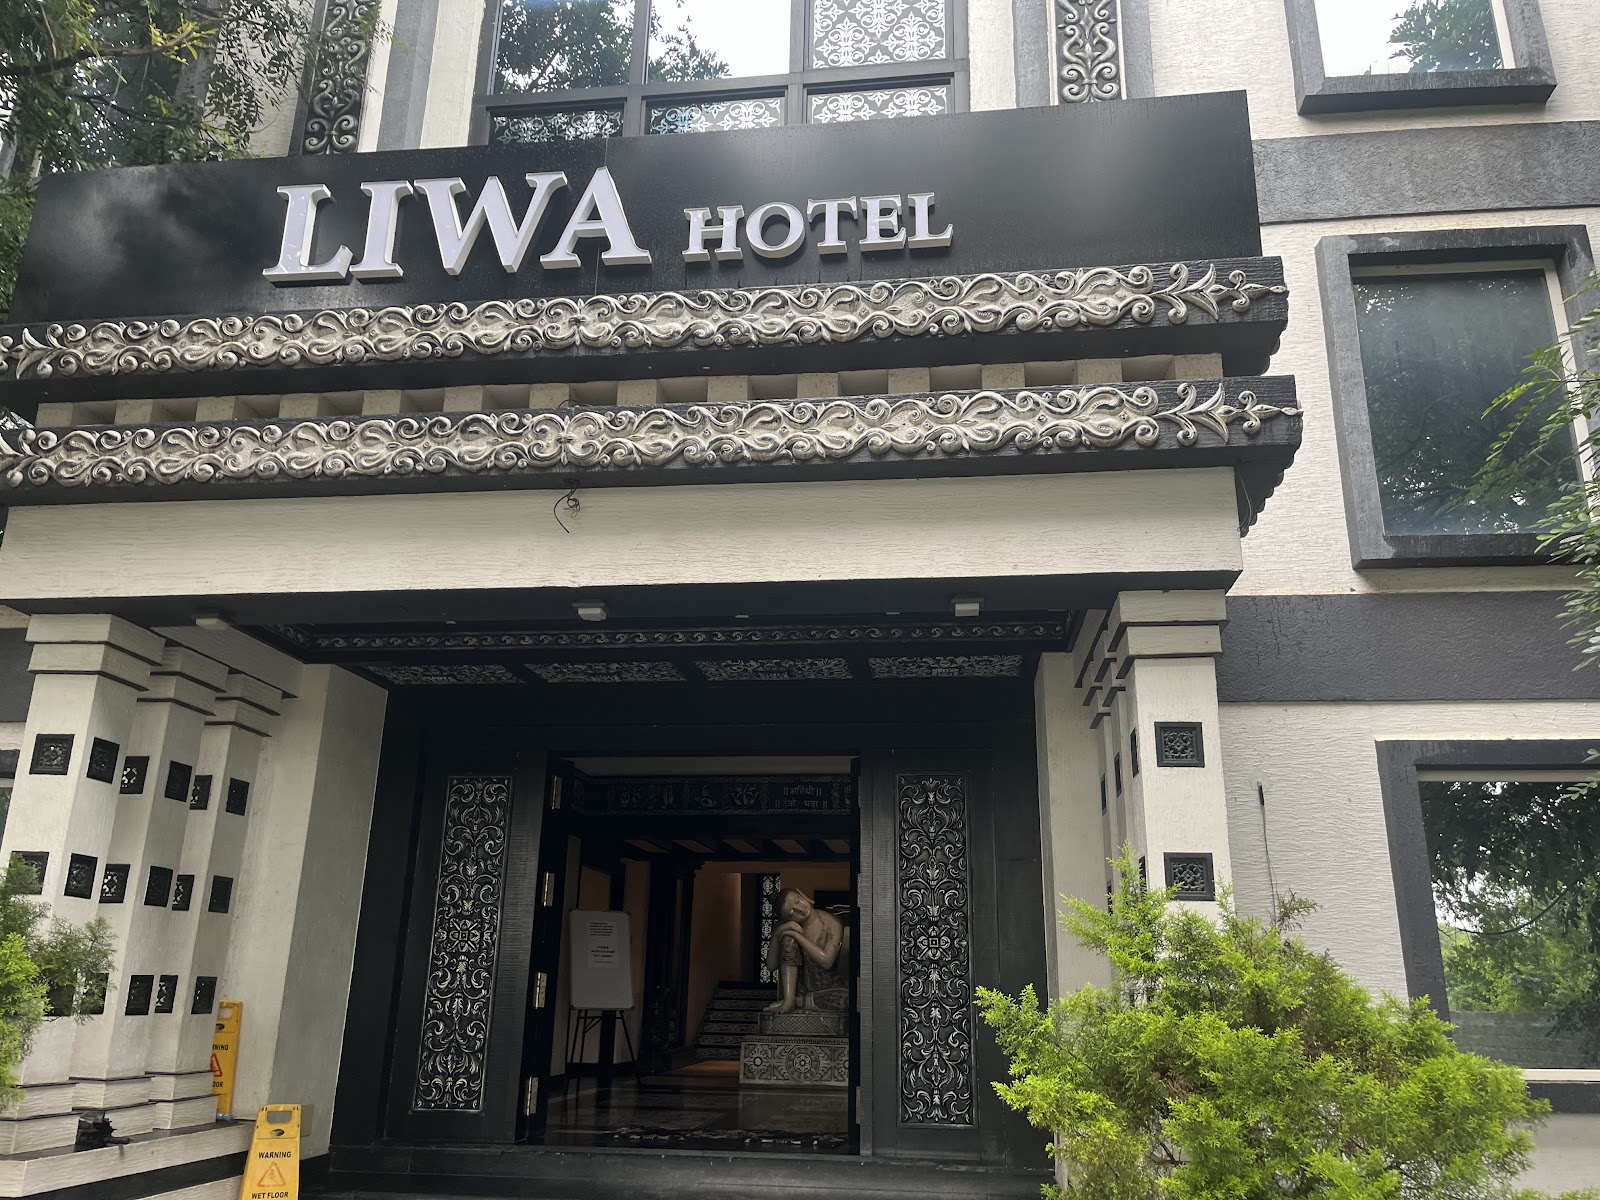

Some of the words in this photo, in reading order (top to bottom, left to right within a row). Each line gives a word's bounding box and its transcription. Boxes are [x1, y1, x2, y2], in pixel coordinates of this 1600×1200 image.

[262, 165, 653, 282] LIWA
[682, 191, 954, 263] HOTEL
[258, 1151, 292, 1159] WARNING
[251, 1192, 266, 1200] WET
[266, 1191, 289, 1199] FLOOR
